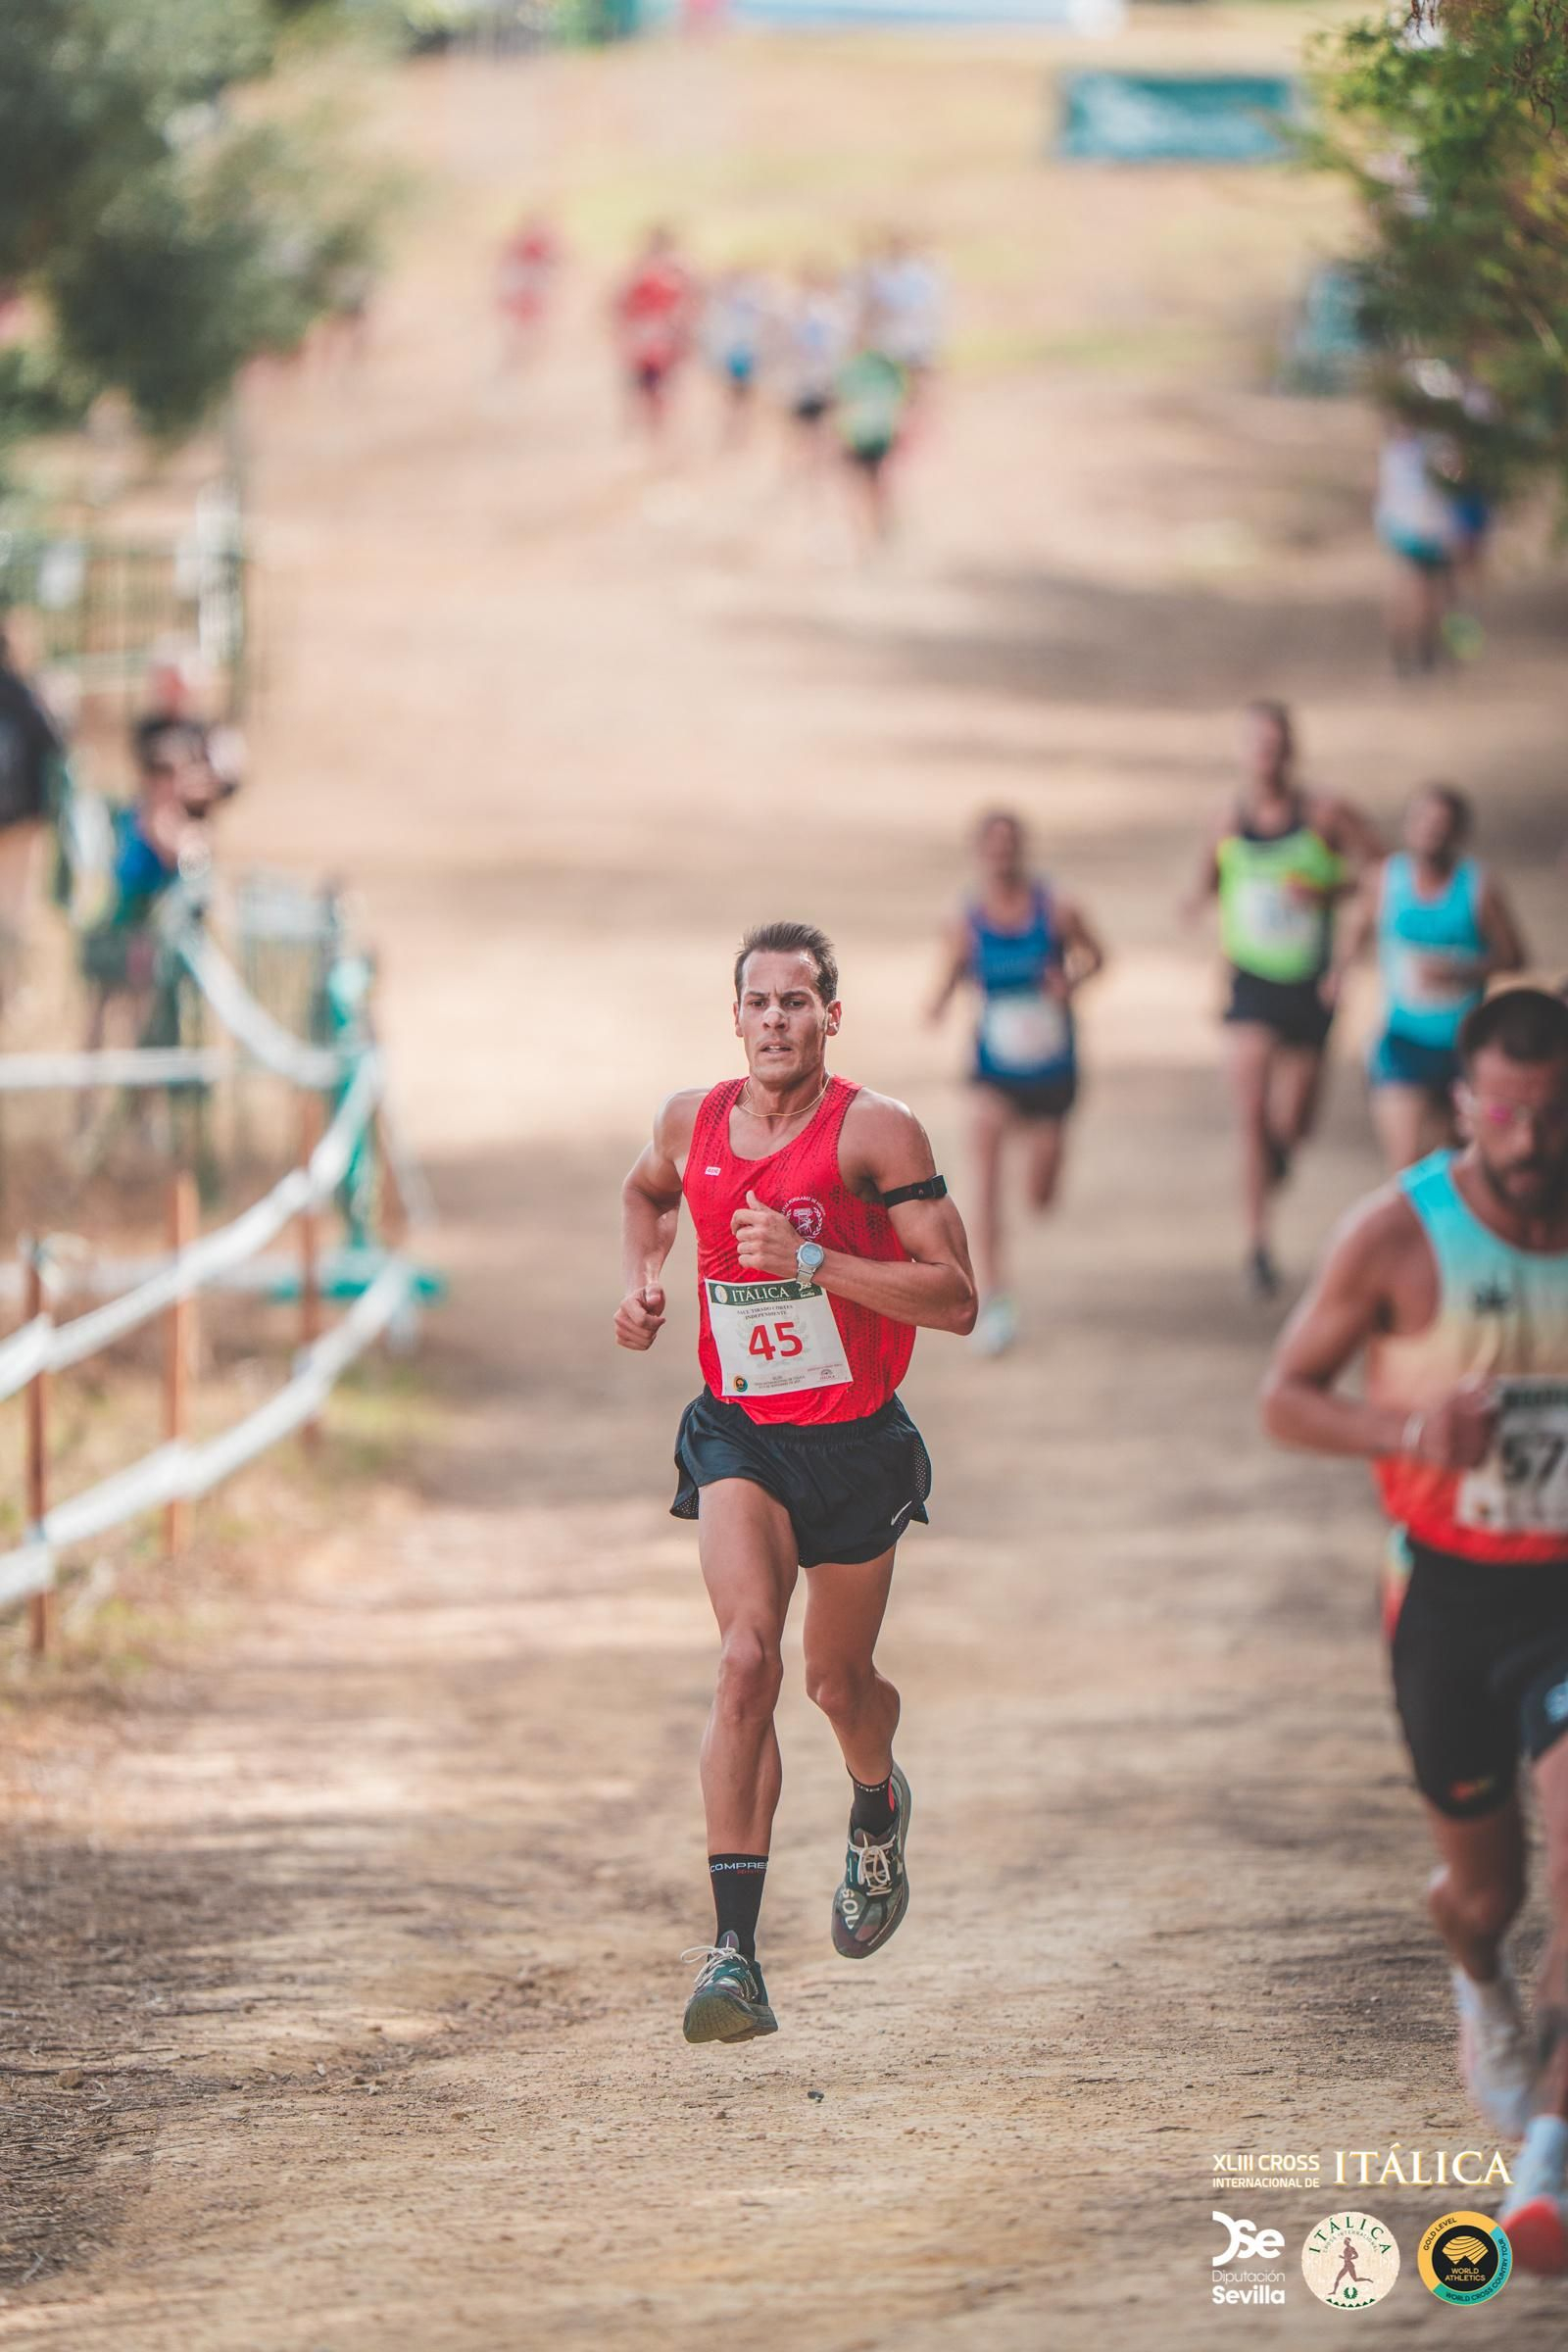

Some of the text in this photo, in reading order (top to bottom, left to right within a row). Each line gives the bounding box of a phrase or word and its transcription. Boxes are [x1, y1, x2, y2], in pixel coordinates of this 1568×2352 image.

[731, 1286, 790, 1302] ITÁLICA
[748, 1321, 804, 1361] 45
[710, 1862, 768, 1873] COMPRE
